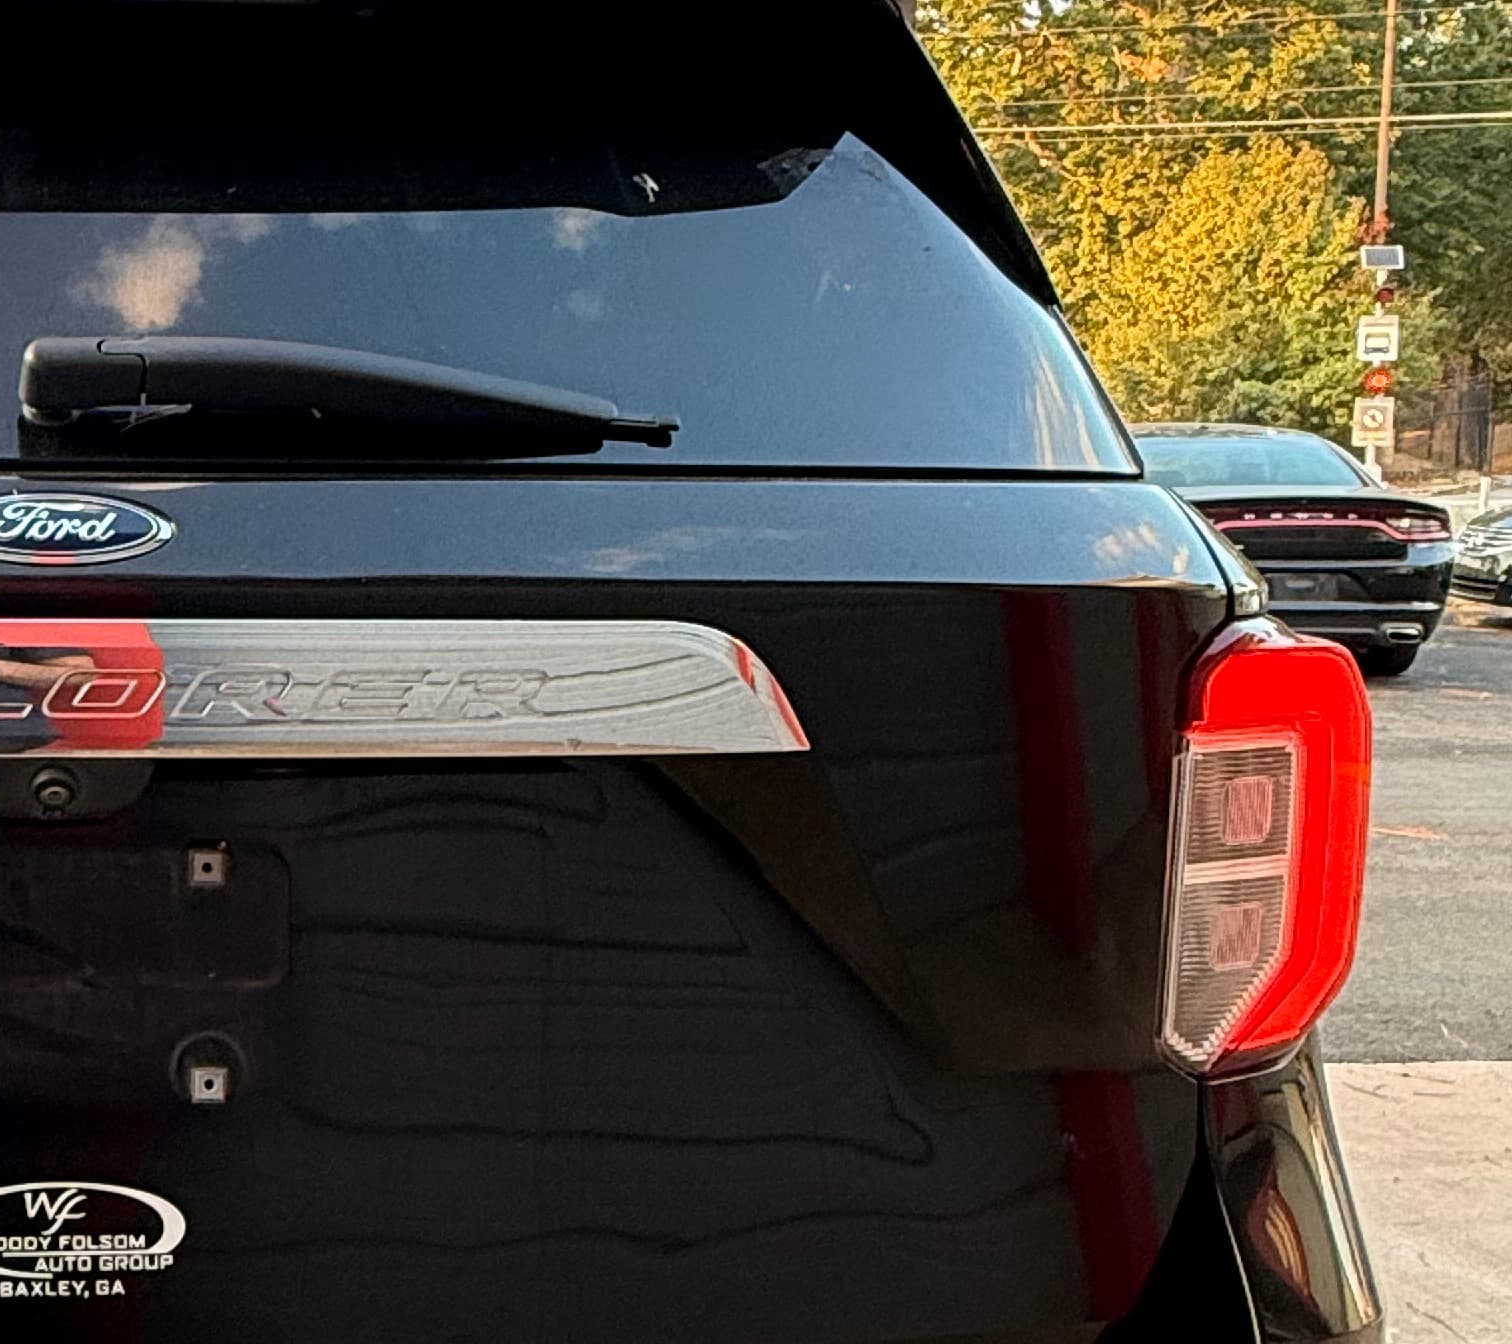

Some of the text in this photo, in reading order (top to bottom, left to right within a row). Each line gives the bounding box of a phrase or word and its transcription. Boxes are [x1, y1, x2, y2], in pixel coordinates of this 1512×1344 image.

[58, 1234, 146, 1250] FOLSOM
[35, 1254, 174, 1272] AUTO GROUP
[0, 1279, 125, 1298] BAXLEY, GA
